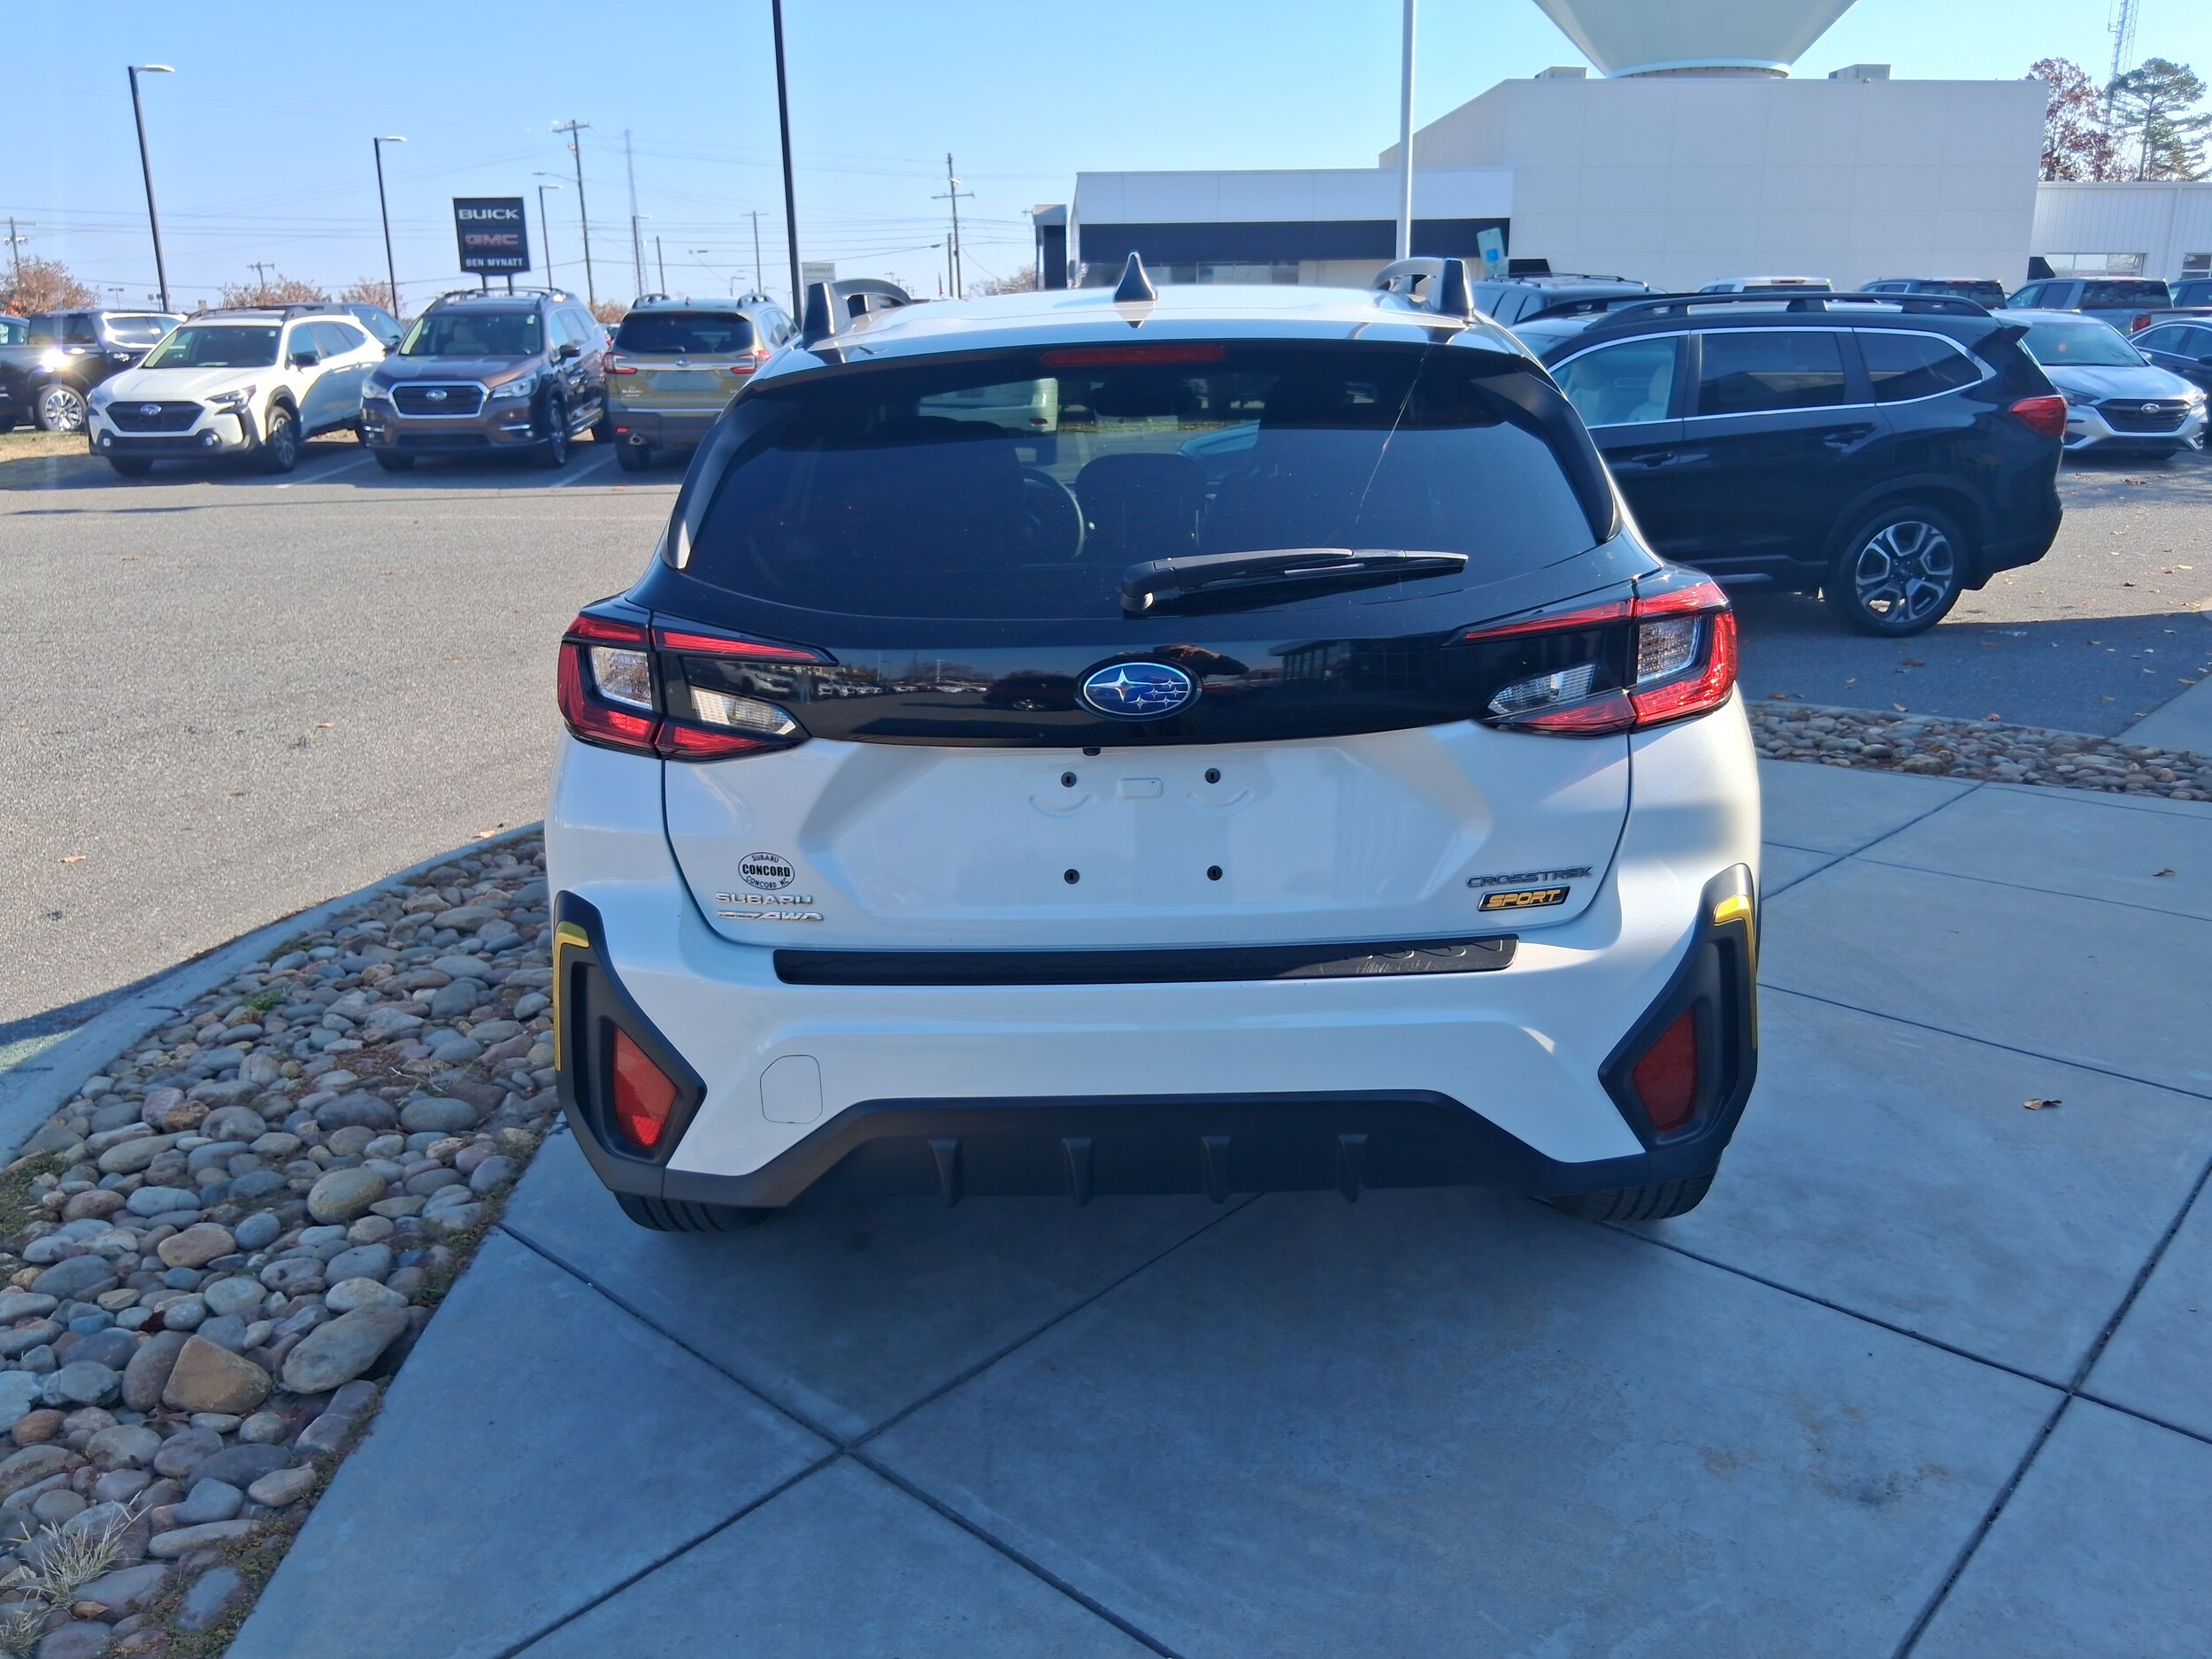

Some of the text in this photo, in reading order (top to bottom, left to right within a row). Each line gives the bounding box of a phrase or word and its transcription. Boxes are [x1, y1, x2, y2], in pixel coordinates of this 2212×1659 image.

[458, 209, 519, 219] BUICK
[465, 234, 518, 245] GMC
[465, 258, 523, 267] BEN MYNATT
[742, 864, 790, 877] CONCORD
[1466, 866, 1593, 887] CROSSTREK
[746, 876, 789, 888] CONCORD NC
[716, 892, 813, 905] SUBARU
[1486, 889, 1561, 908] SPORT
[759, 910, 825, 921] AWD
